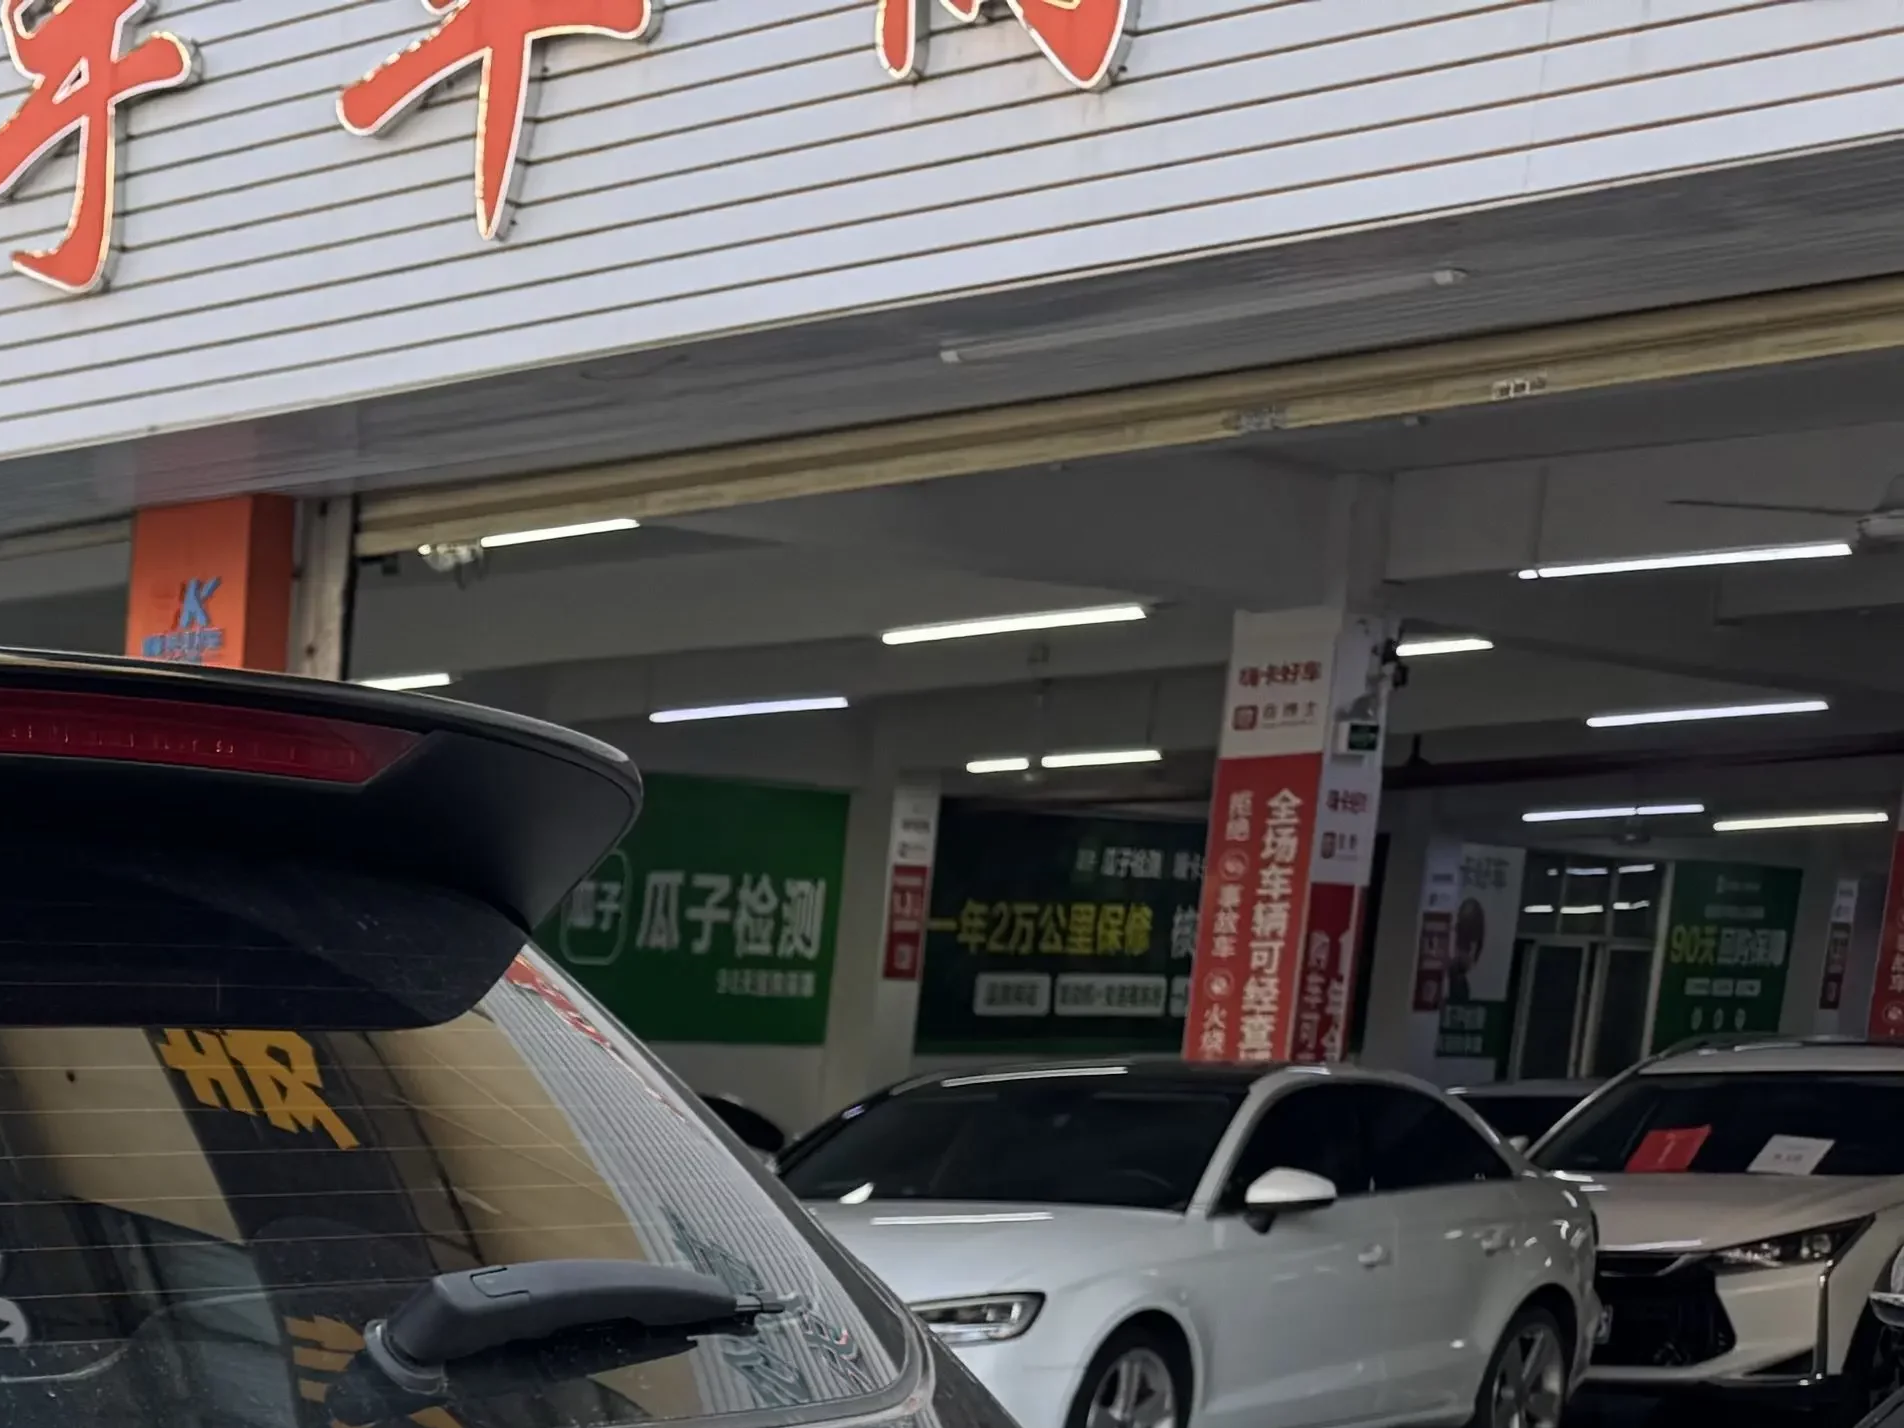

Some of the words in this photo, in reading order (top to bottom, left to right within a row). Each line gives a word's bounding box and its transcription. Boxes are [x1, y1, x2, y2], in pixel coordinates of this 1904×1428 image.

[636, 870, 828, 962] 瓜子检测
[928, 898, 1153, 958] 一年2万公里保修
